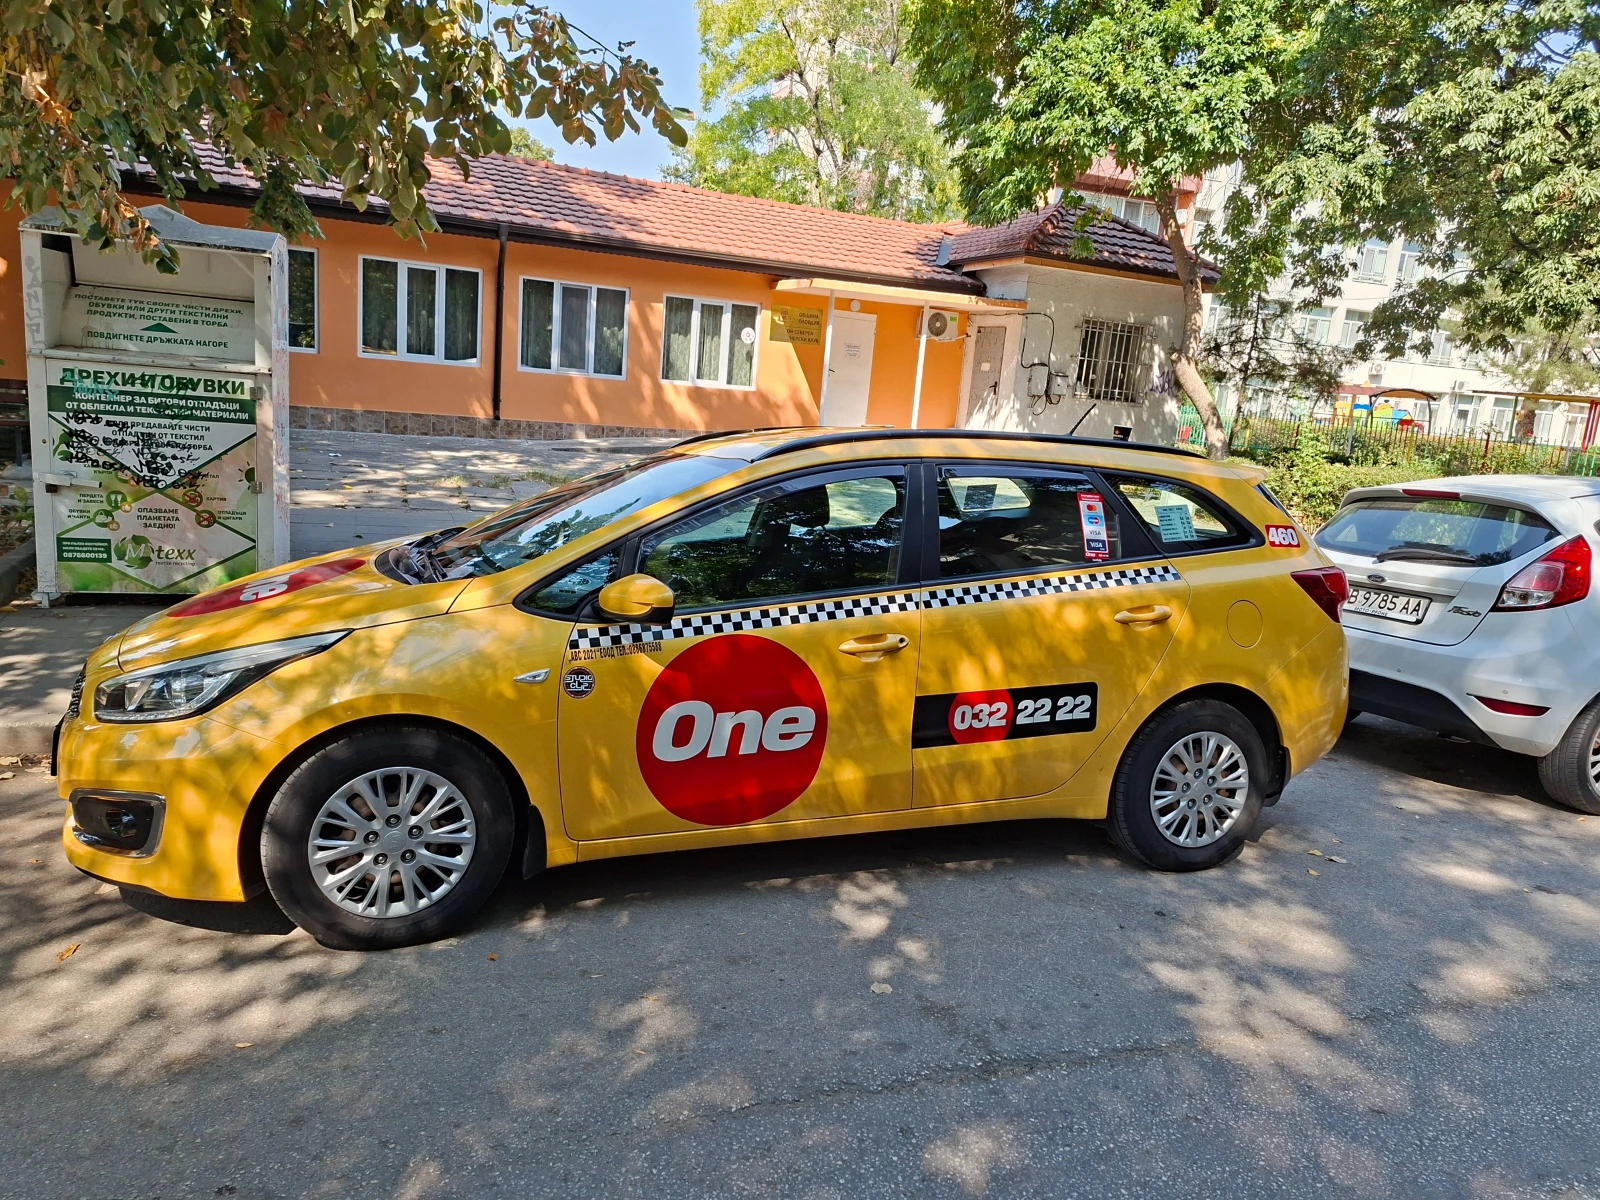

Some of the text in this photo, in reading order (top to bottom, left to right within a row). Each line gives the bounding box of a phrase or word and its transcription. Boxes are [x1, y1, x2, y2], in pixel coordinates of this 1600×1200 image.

[74, 294, 126, 303] ПОСТАВЕТЕ
[146, 300, 180, 308] СВОИТЕ
[86, 309, 137, 320] ПРОДУКТИ,
[140, 314, 192, 324] ПОСТАВЕНИ
[88, 302, 228, 320] ОБУВКИ ИЛИ ДРУГИ ТЕКСТИЛНИ
[87, 330, 228, 348] ПОВДИГНЕТЕ ДРЪЖКАТА НАГОРЕ
[60, 368, 136, 387] ДРЕХИ
[161, 374, 244, 395] ОБУВКИ
[80, 402, 125, 412] ОБЛЕКЛА
[193, 410, 248, 420] МАТЕРИАЛИ
[134, 396, 146, 404] ЗА
[148, 397, 185, 406] БИТОВИ
[188, 400, 240, 410] ОТПАДЪЦИ
[1268, 526, 1298, 546] 460
[1349, 589, 1422, 616] B 9785 AA
[954, 695, 1092, 730] 032 22 22
[652, 700, 816, 762] One
